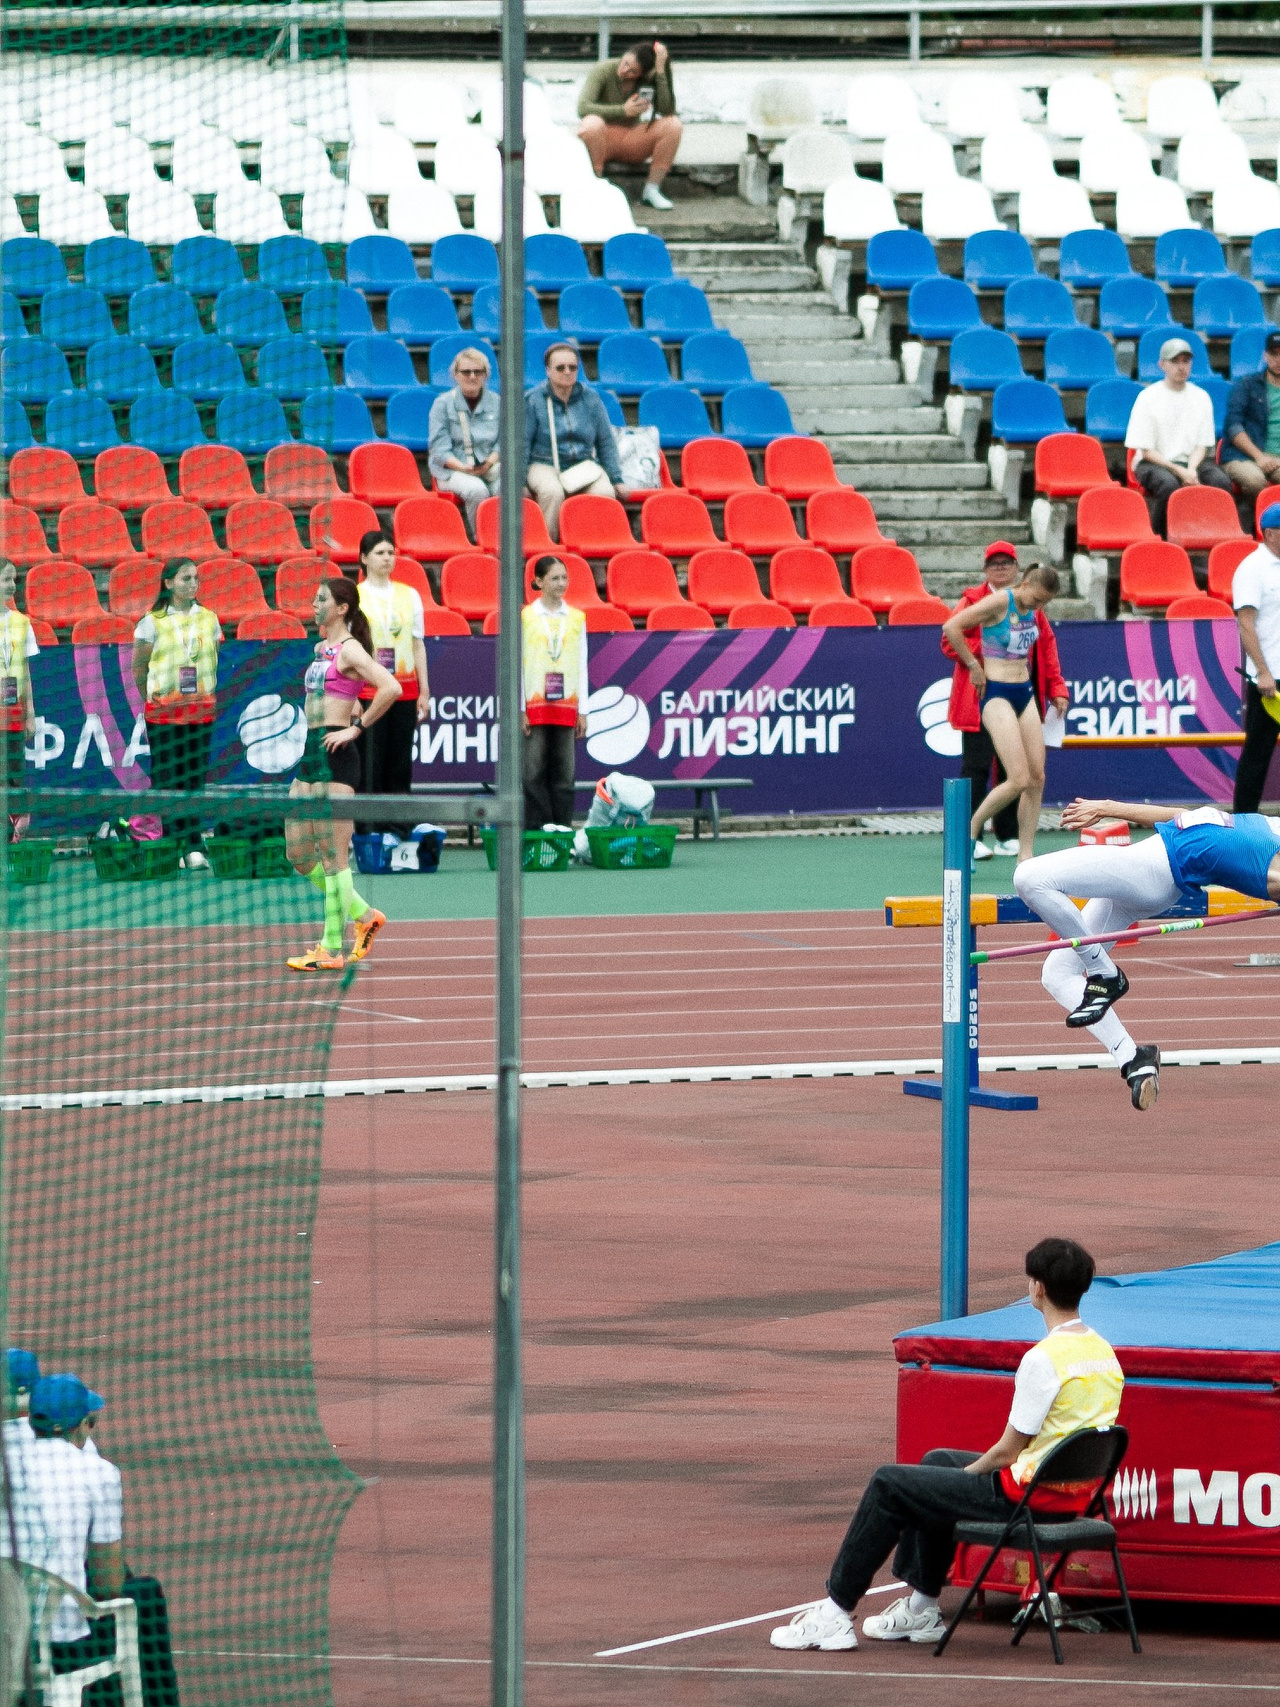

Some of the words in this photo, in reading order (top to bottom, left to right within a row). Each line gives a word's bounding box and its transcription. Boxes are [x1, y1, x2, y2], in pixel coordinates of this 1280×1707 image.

[660, 683, 855, 714] БАЛТИЙСКИЙ
[1065, 675, 1196, 704] ИЙСКИЙ
[658, 714, 855, 759] ЛИЗИНГ
